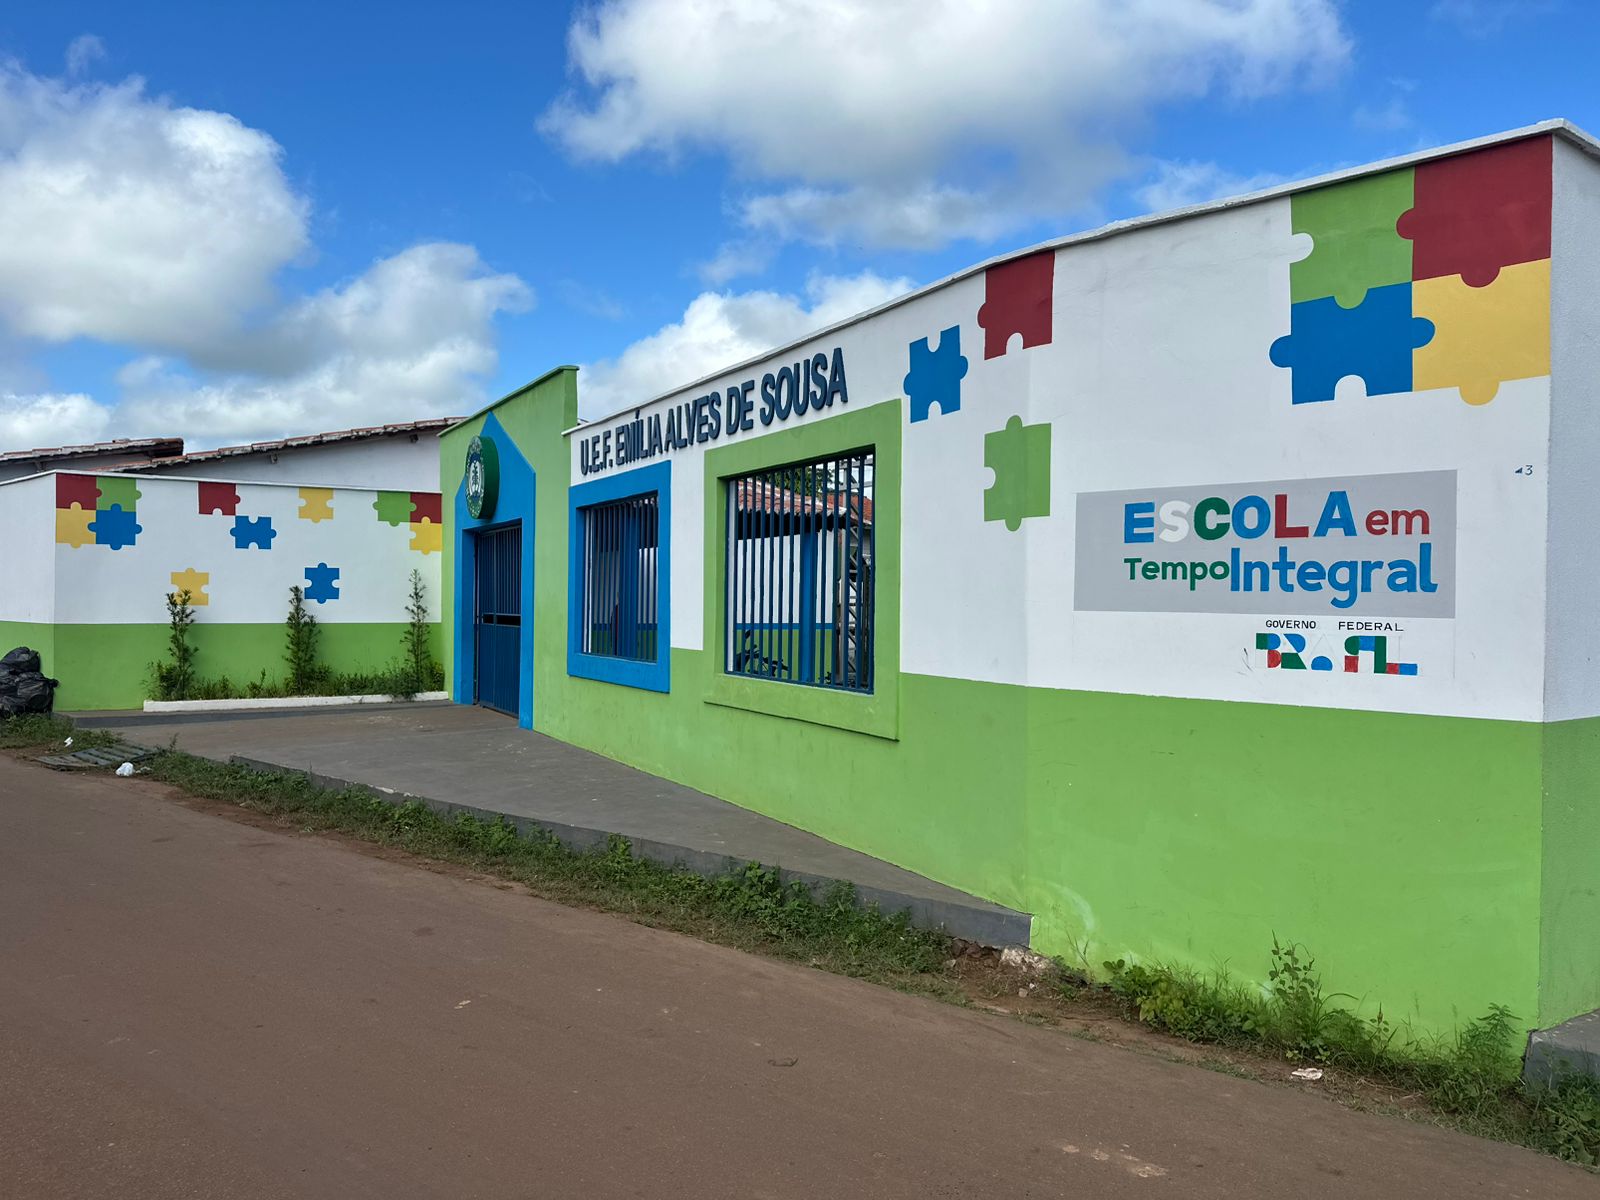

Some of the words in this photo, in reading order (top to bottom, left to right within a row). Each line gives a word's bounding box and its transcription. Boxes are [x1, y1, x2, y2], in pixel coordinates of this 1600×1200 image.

[580, 430, 613, 476] U.E.F.
[615, 410, 664, 466] EMÍLIA
[663, 391, 722, 453] ALVES
[726, 379, 755, 436] DE
[759, 347, 849, 427] SOUSA
[1123, 490, 1358, 544] ESCOLA
[1365, 508, 1430, 536] em
[1123, 557, 1230, 591] Tempo
[1230, 542, 1439, 609] Integral
[1265, 619, 1317, 630] GOVERNO
[1338, 621, 1404, 632] FEDERAL
